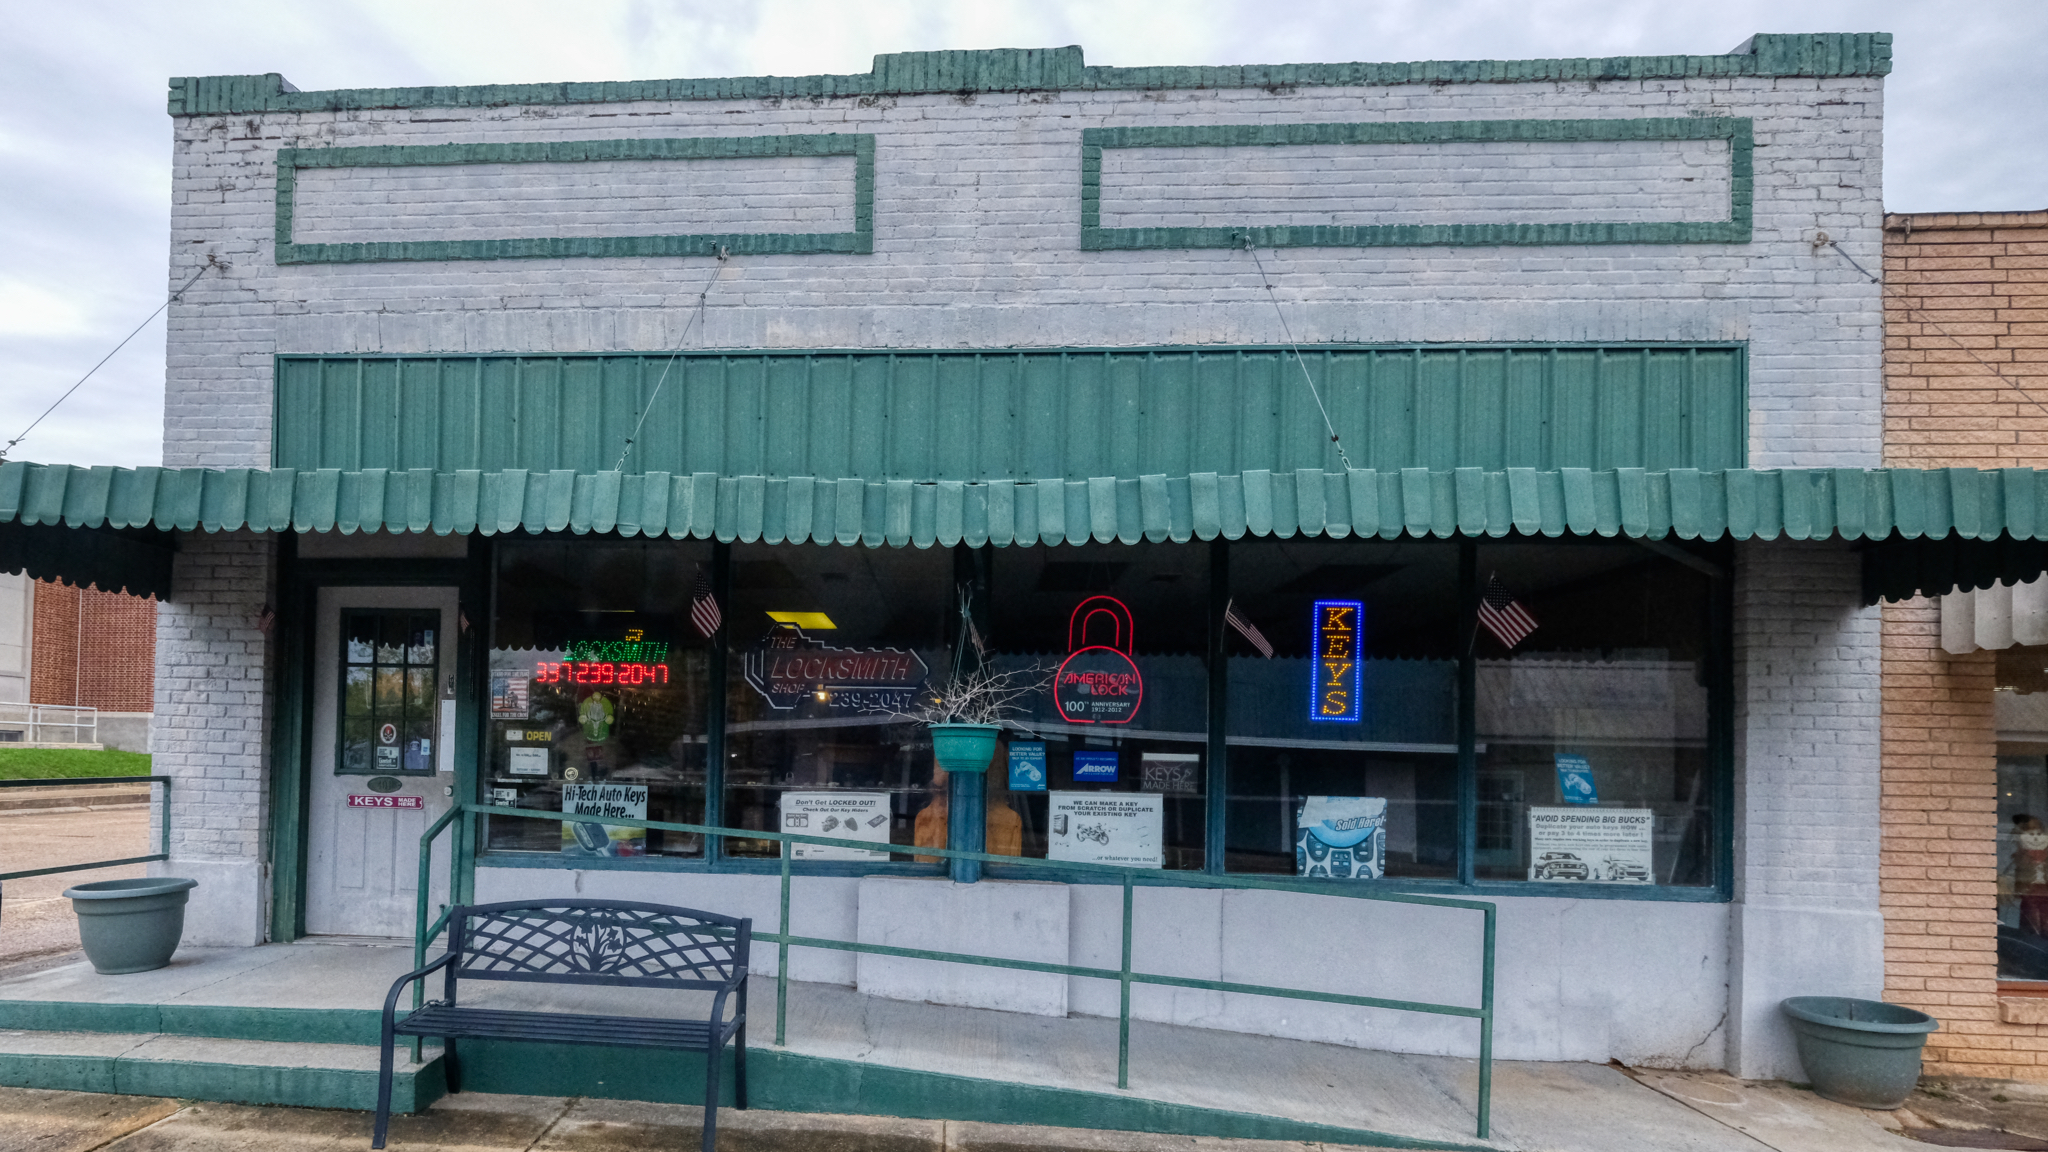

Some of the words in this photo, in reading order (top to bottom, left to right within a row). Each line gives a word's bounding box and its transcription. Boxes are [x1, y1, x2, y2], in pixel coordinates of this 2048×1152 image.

[769, 636, 798, 649] THE
[563, 640, 669, 662] LOCKSMITH
[1322, 607, 1353, 715] KEYS
[536, 662, 669, 684] 337-239-2047
[770, 656, 911, 681] LOCKSMITH
[1063, 672, 1136, 685] AMERICAN
[771, 683, 805, 694] SHOP
[1090, 684, 1128, 696] LOCK
[828, 692, 912, 708] 239-2047
[526, 730, 552, 742] OPEN
[1075, 762, 1117, 775] ARROW
[1144, 766, 1181, 781] KEYS
[1142, 780, 1170, 791] MADE
[1172, 780, 1194, 791] HERE
[354, 796, 394, 807] KEYS
[564, 785, 598, 801] Hi-Tech
[598, 786, 622, 802] Auto
[623, 786, 647, 807] Keys
[574, 801, 602, 817] Made
[603, 802, 635, 819] Here...
[1335, 817, 1356, 831] Sold
[1357, 815, 1384, 829] Here!
[1560, 815, 1601, 823] SPENDING
[1601, 816, 1617, 824] BIG
